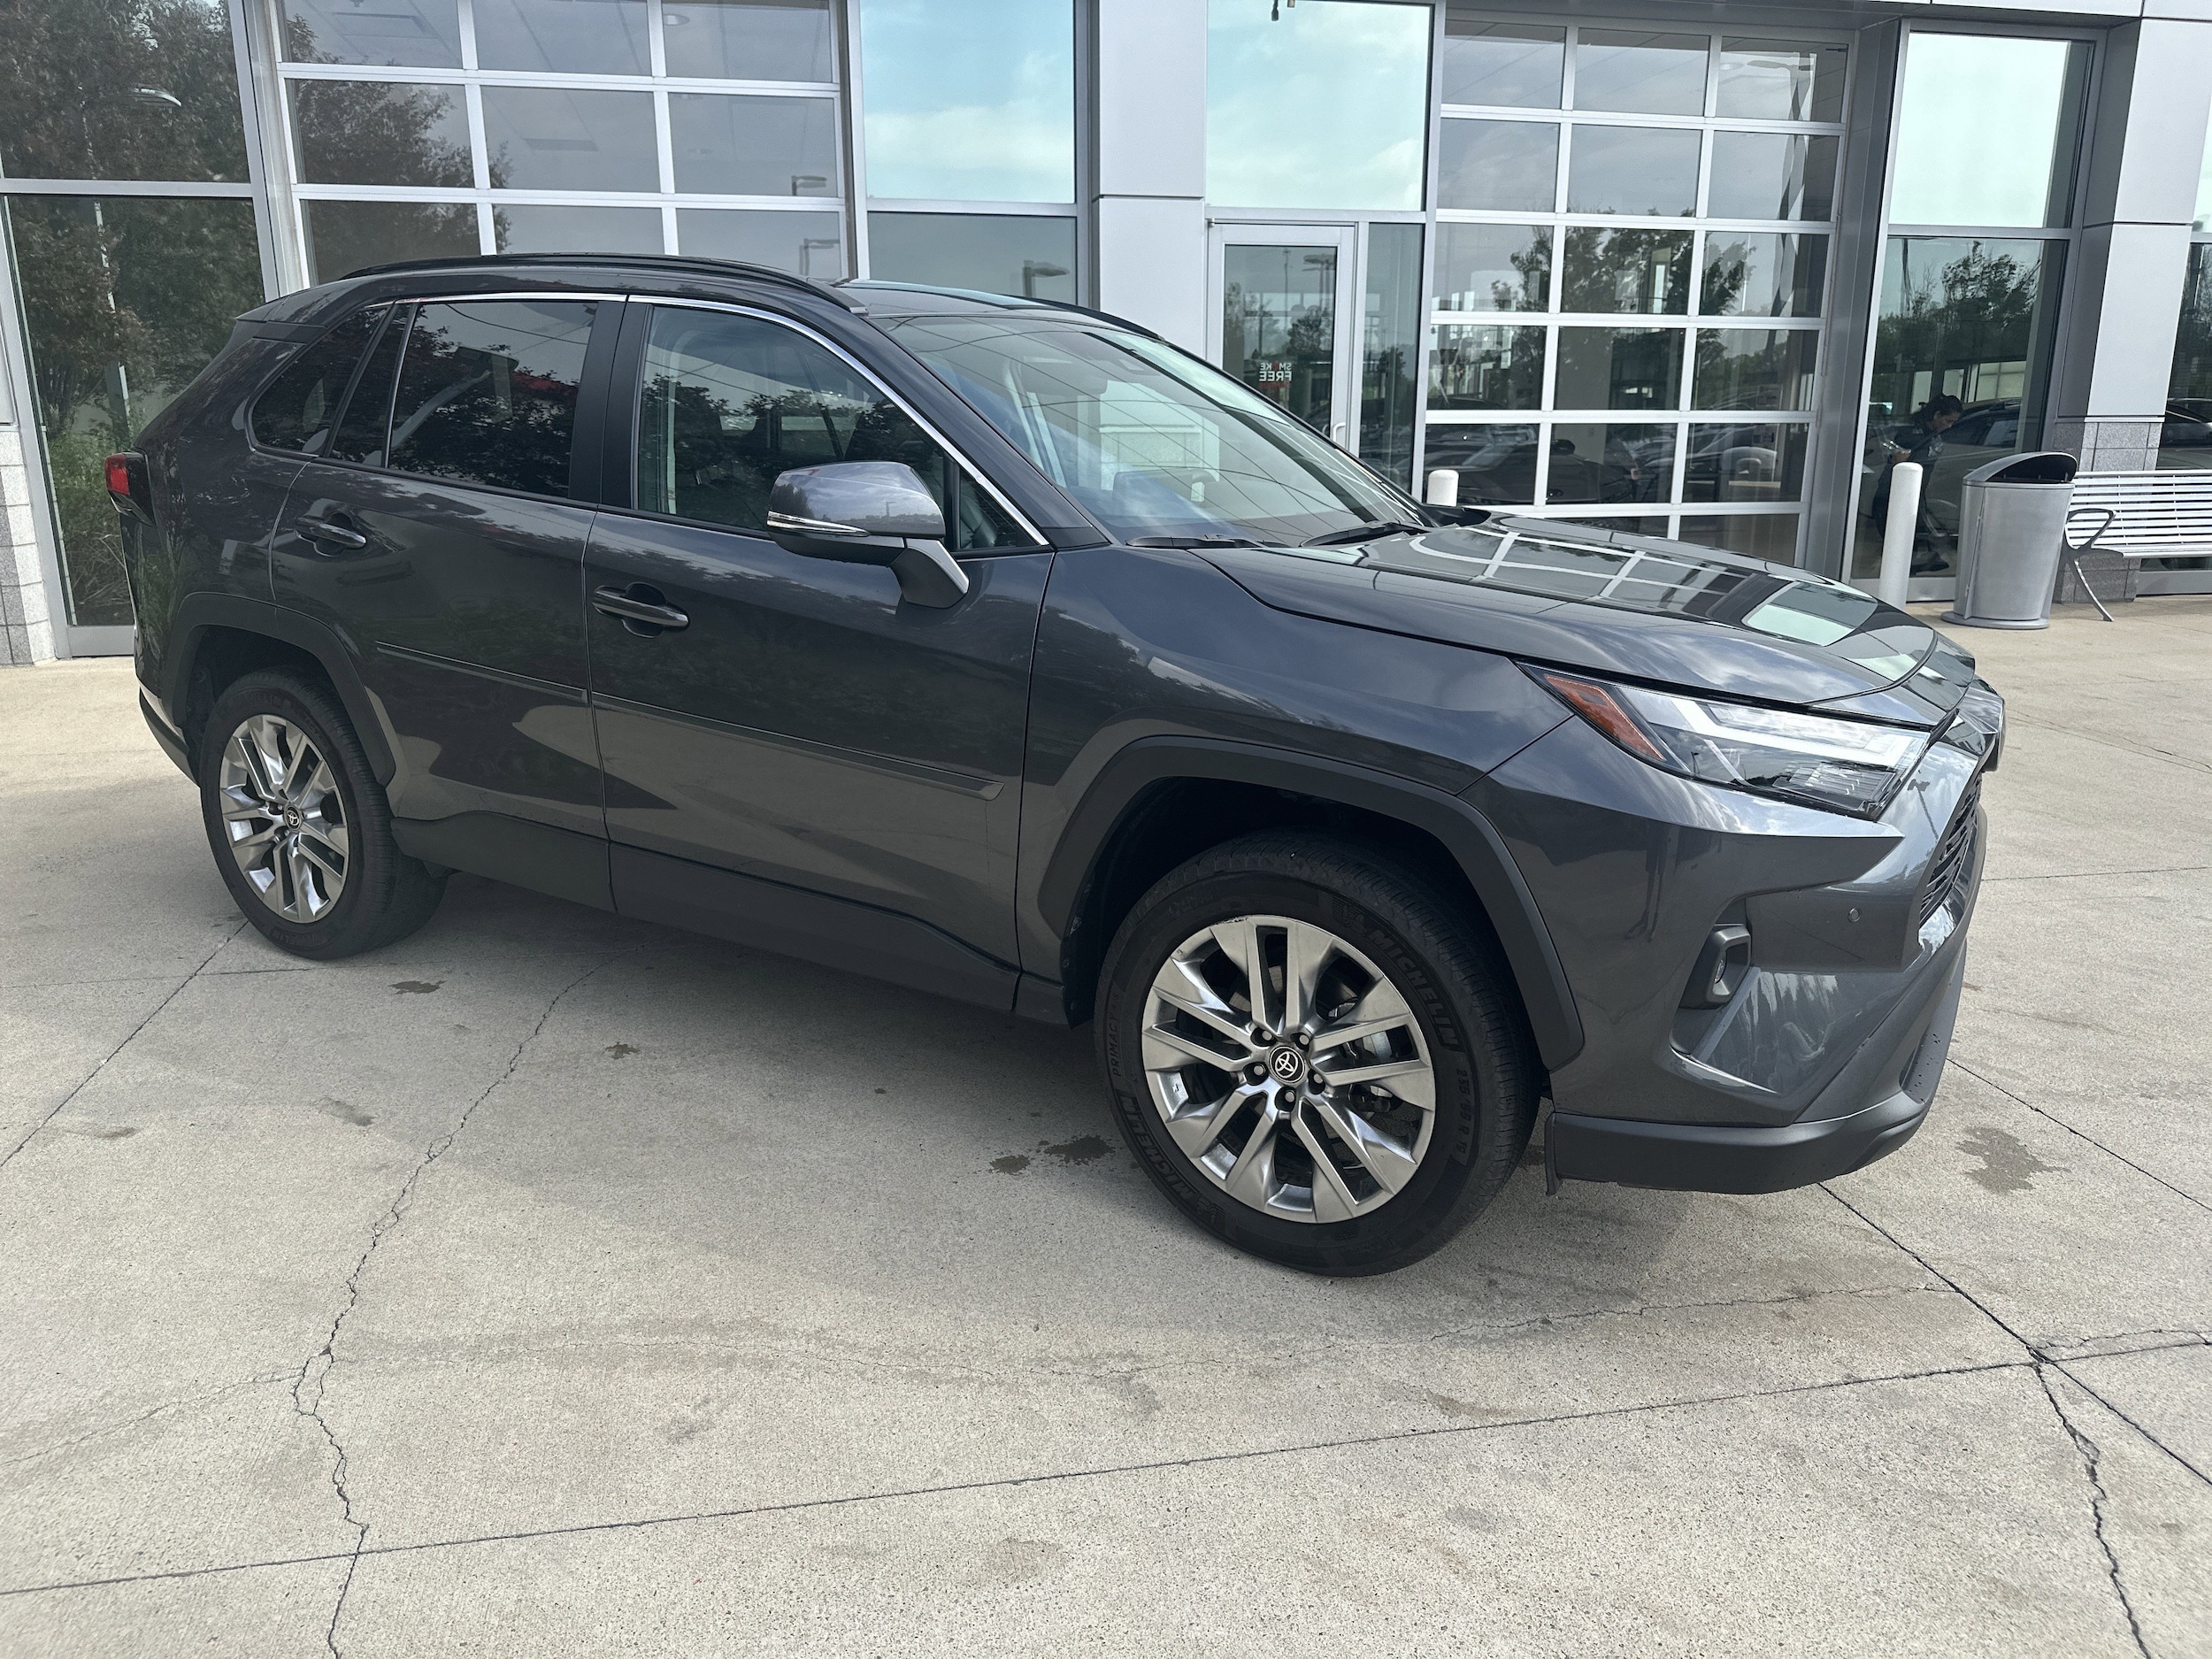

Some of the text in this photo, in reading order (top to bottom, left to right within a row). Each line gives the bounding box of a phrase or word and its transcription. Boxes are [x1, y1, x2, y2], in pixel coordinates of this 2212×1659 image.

[1372, 929, 1460, 1046] MICHELIN
[1109, 1013, 1122, 1077] PRIMACY
[1456, 1068, 1471, 1121] 235/55
[1120, 1096, 1195, 1201] MICHELIN
[1458, 1125, 1471, 1136] R
